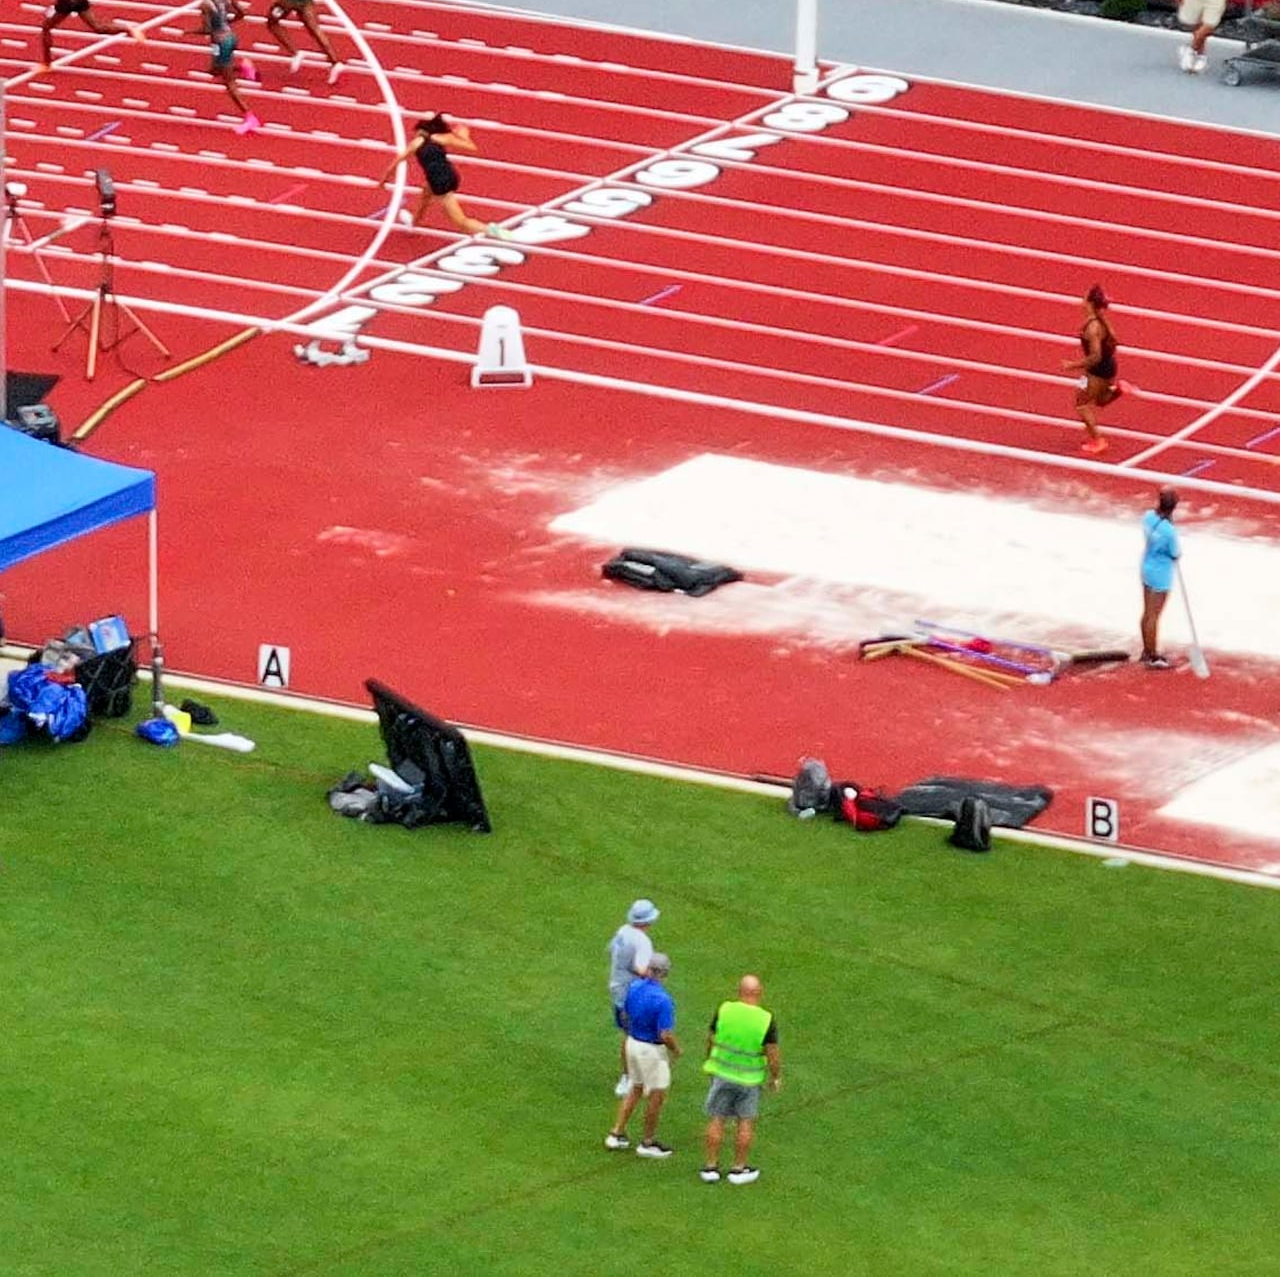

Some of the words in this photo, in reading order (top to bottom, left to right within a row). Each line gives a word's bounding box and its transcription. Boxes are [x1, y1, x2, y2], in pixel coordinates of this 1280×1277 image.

[369, 273, 463, 304] 2
[439, 245, 524, 275] 3
[564, 188, 653, 217] 5
[636, 159, 719, 188] 6
[691, 131, 783, 160] 7
[763, 102, 849, 132] 8
[827, 74, 909, 103] 9
[261, 648, 285, 686] A
[1092, 799, 1113, 837] B
